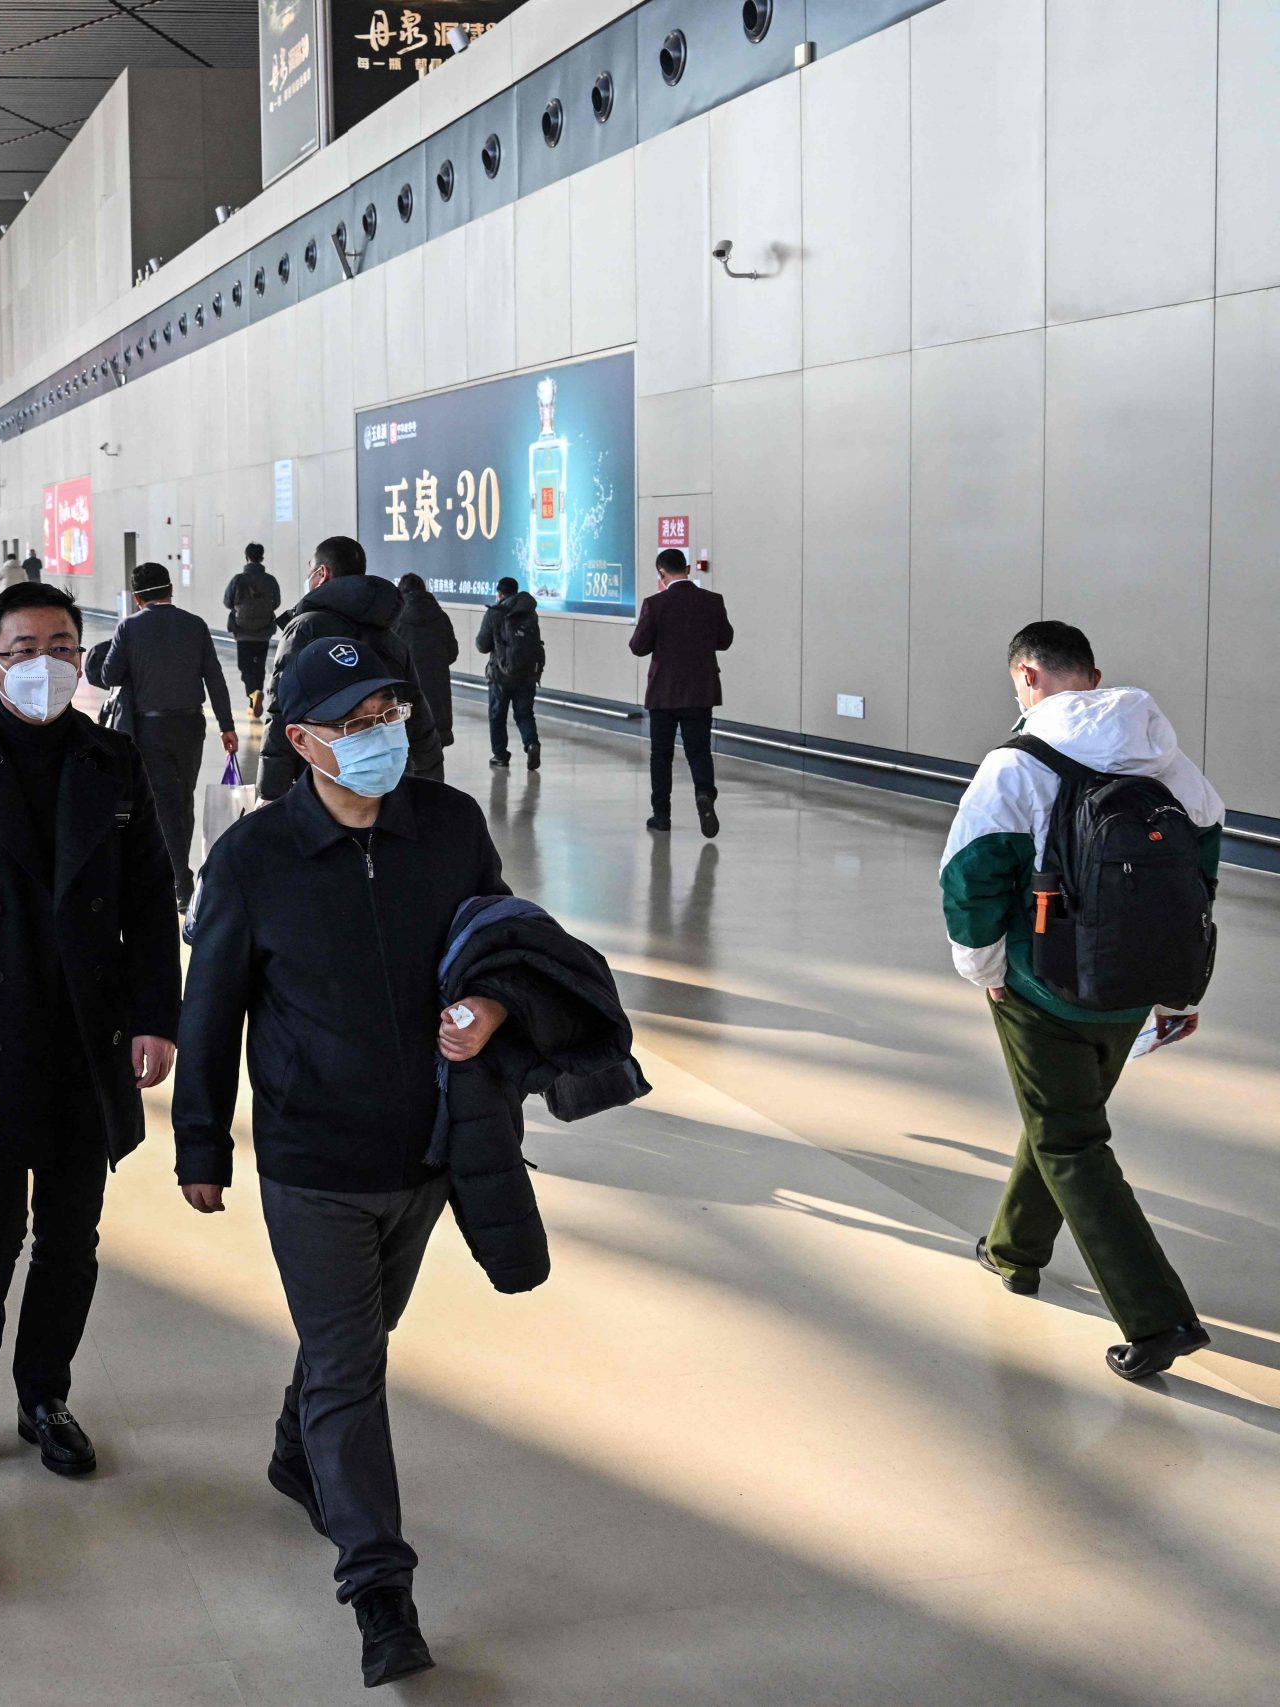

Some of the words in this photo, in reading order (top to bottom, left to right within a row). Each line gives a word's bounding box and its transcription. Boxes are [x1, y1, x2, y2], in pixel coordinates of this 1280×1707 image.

[662, 519, 685, 537] 消火栓
[585, 572, 609, 597] 588
